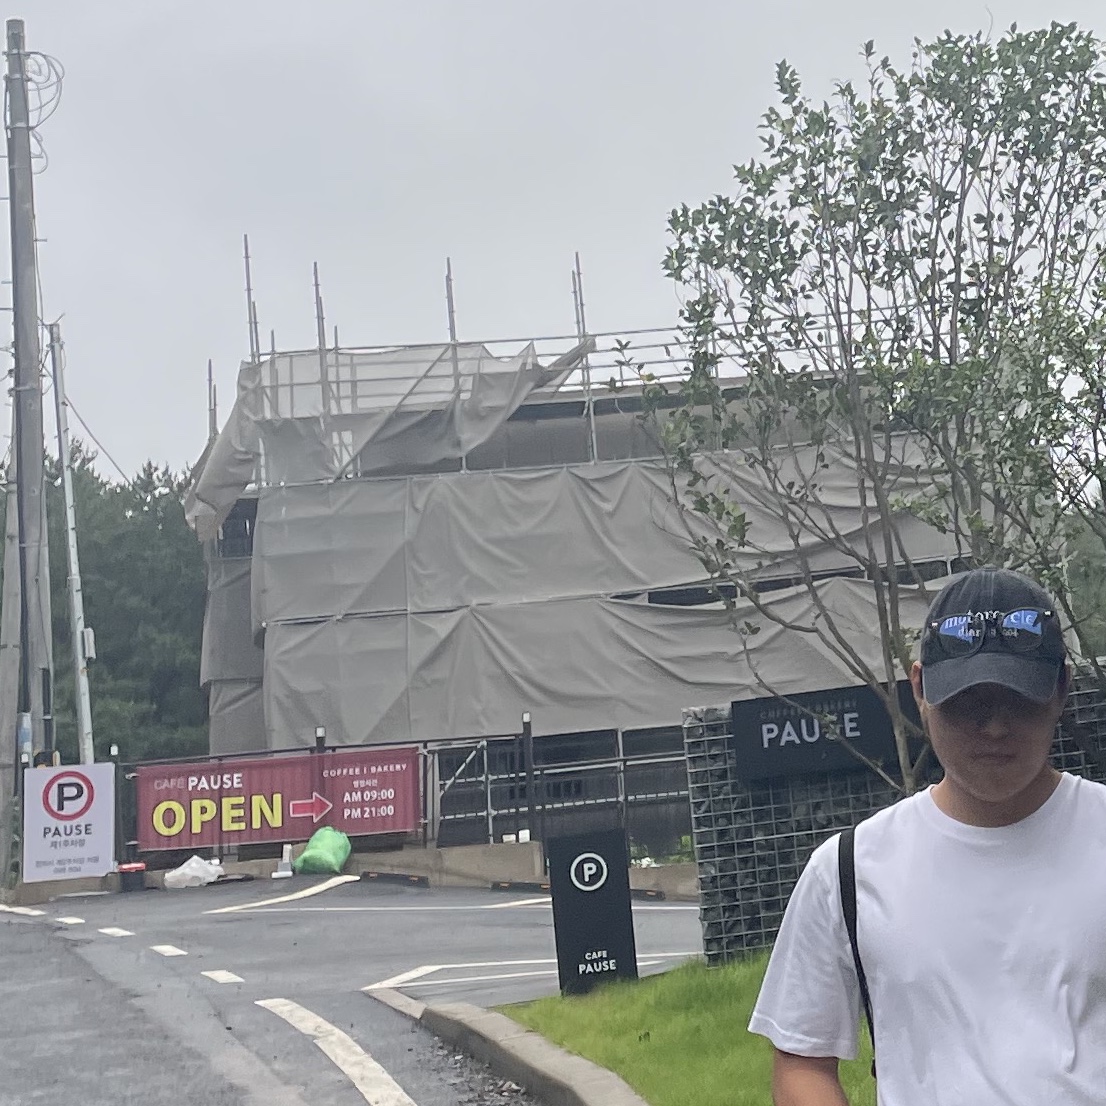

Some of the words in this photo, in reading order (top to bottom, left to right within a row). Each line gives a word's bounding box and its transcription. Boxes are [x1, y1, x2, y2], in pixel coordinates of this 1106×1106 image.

[322, 767, 360, 778] COFFEE
[370, 763, 407, 774] BAKERY
[187, 773, 243, 791] PAUSE
[57, 782, 84, 812] P
[343, 791, 361, 803] AM
[363, 788, 395, 801] 09:00
[152, 792, 283, 837] OPEN
[343, 807, 361, 819] PM
[363, 805, 395, 818] 21:00
[43, 823, 93, 839] PAUSE
[583, 862, 597, 882] P
[585, 950, 607, 960] CAFE
[578, 960, 617, 975] PAUSE
